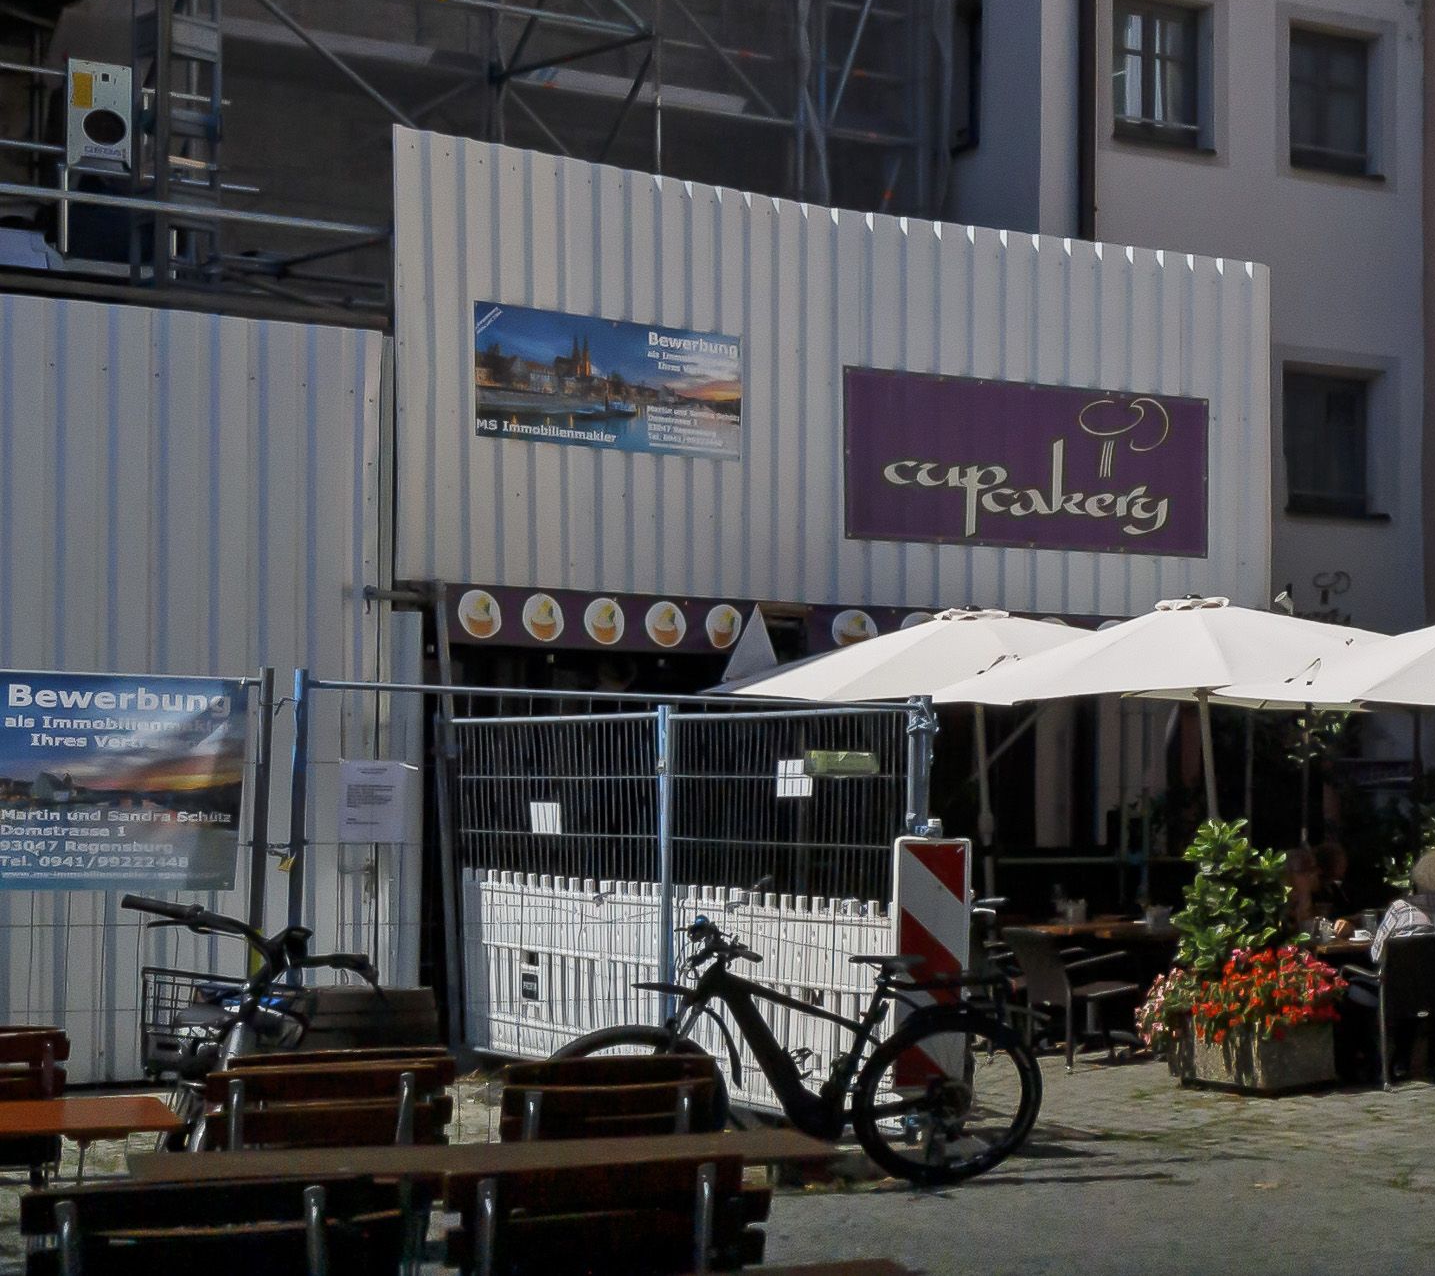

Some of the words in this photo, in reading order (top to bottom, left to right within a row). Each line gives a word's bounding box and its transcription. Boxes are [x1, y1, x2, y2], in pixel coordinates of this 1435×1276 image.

[85, 145, 123, 158] GEDA
[648, 331, 738, 359] Bewerbung
[476, 418, 498, 431] MS
[502, 420, 617, 444] Immobilienmakler
[884, 439, 1169, 538] cupcakery
[8, 684, 232, 718] Bewerbung
[5, 715, 35, 729] als
[31, 733, 88, 748] Ihres
[1, 809, 60, 822] Martin
[67, 809, 101, 822] und
[108, 810, 171, 823] Sandra
[1, 825, 110, 838] Domstrasse
[117, 826, 127, 837] 1
[65, 841, 174, 855] Regensburg
[1, 856, 32, 868] Tel.
